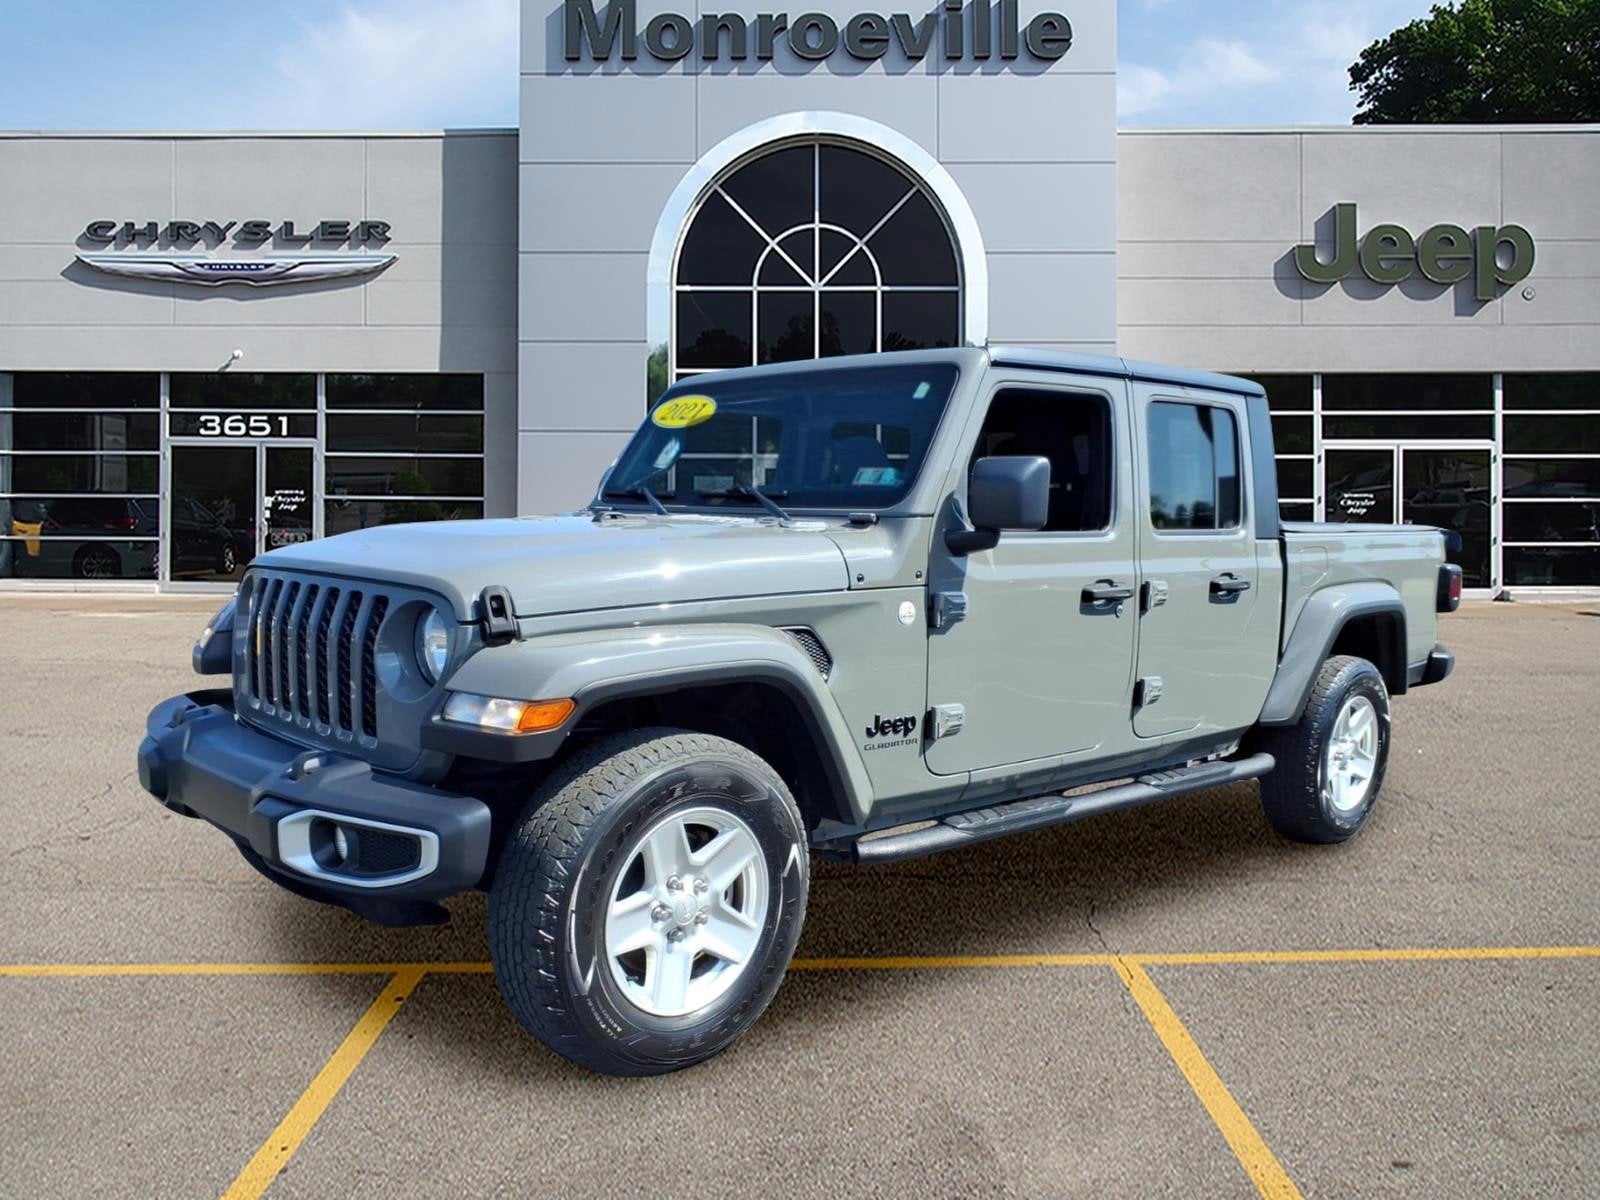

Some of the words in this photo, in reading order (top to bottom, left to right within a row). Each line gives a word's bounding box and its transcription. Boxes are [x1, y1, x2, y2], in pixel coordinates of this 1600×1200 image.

[564, 0, 1073, 61] Monroeville
[85, 220, 392, 242] CHRYSLER
[1295, 202, 1535, 300] Jeep
[659, 402, 708, 421] 2021
[199, 415, 288, 436] 3651
[865, 714, 916, 738] Jeep
[863, 738, 918, 751] GLADIATOR
